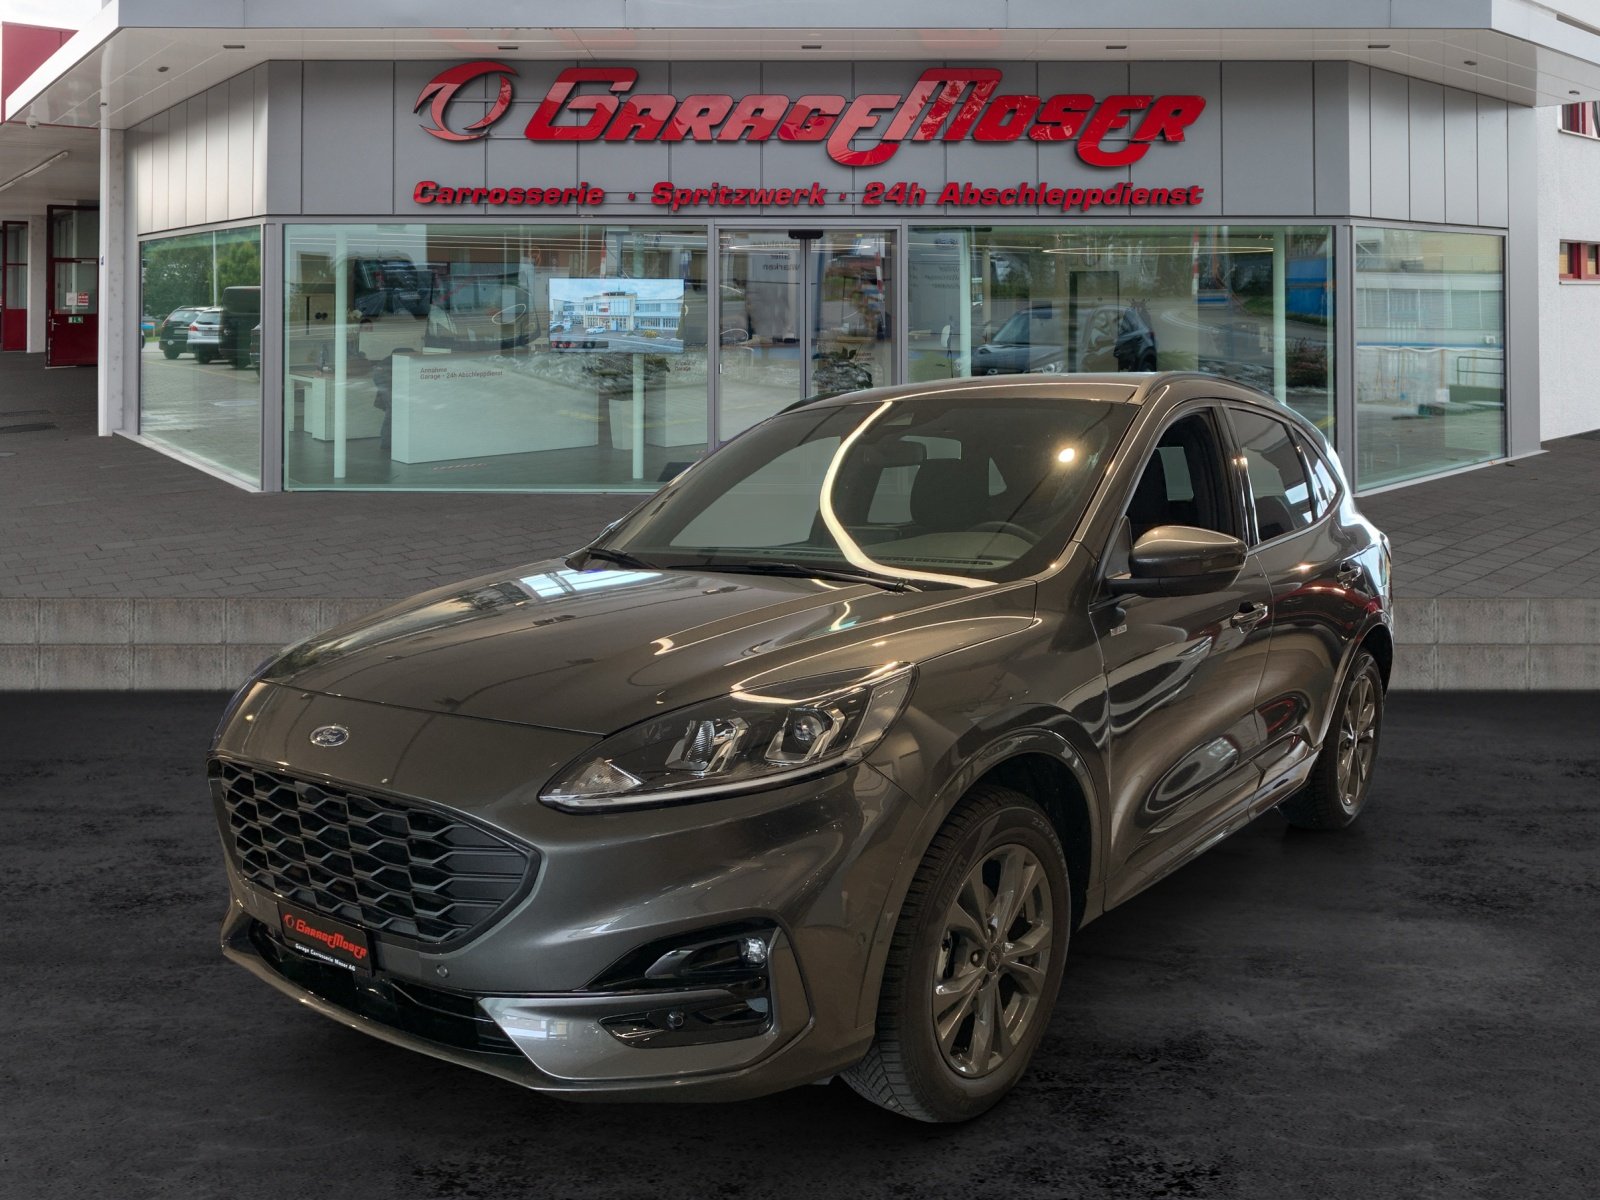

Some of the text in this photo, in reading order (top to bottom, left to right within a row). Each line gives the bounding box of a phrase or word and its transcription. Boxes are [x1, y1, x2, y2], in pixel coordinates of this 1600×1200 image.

[412, 180, 1205, 212] Carrosserie Spritzwerk 24h Abschleppdienst
